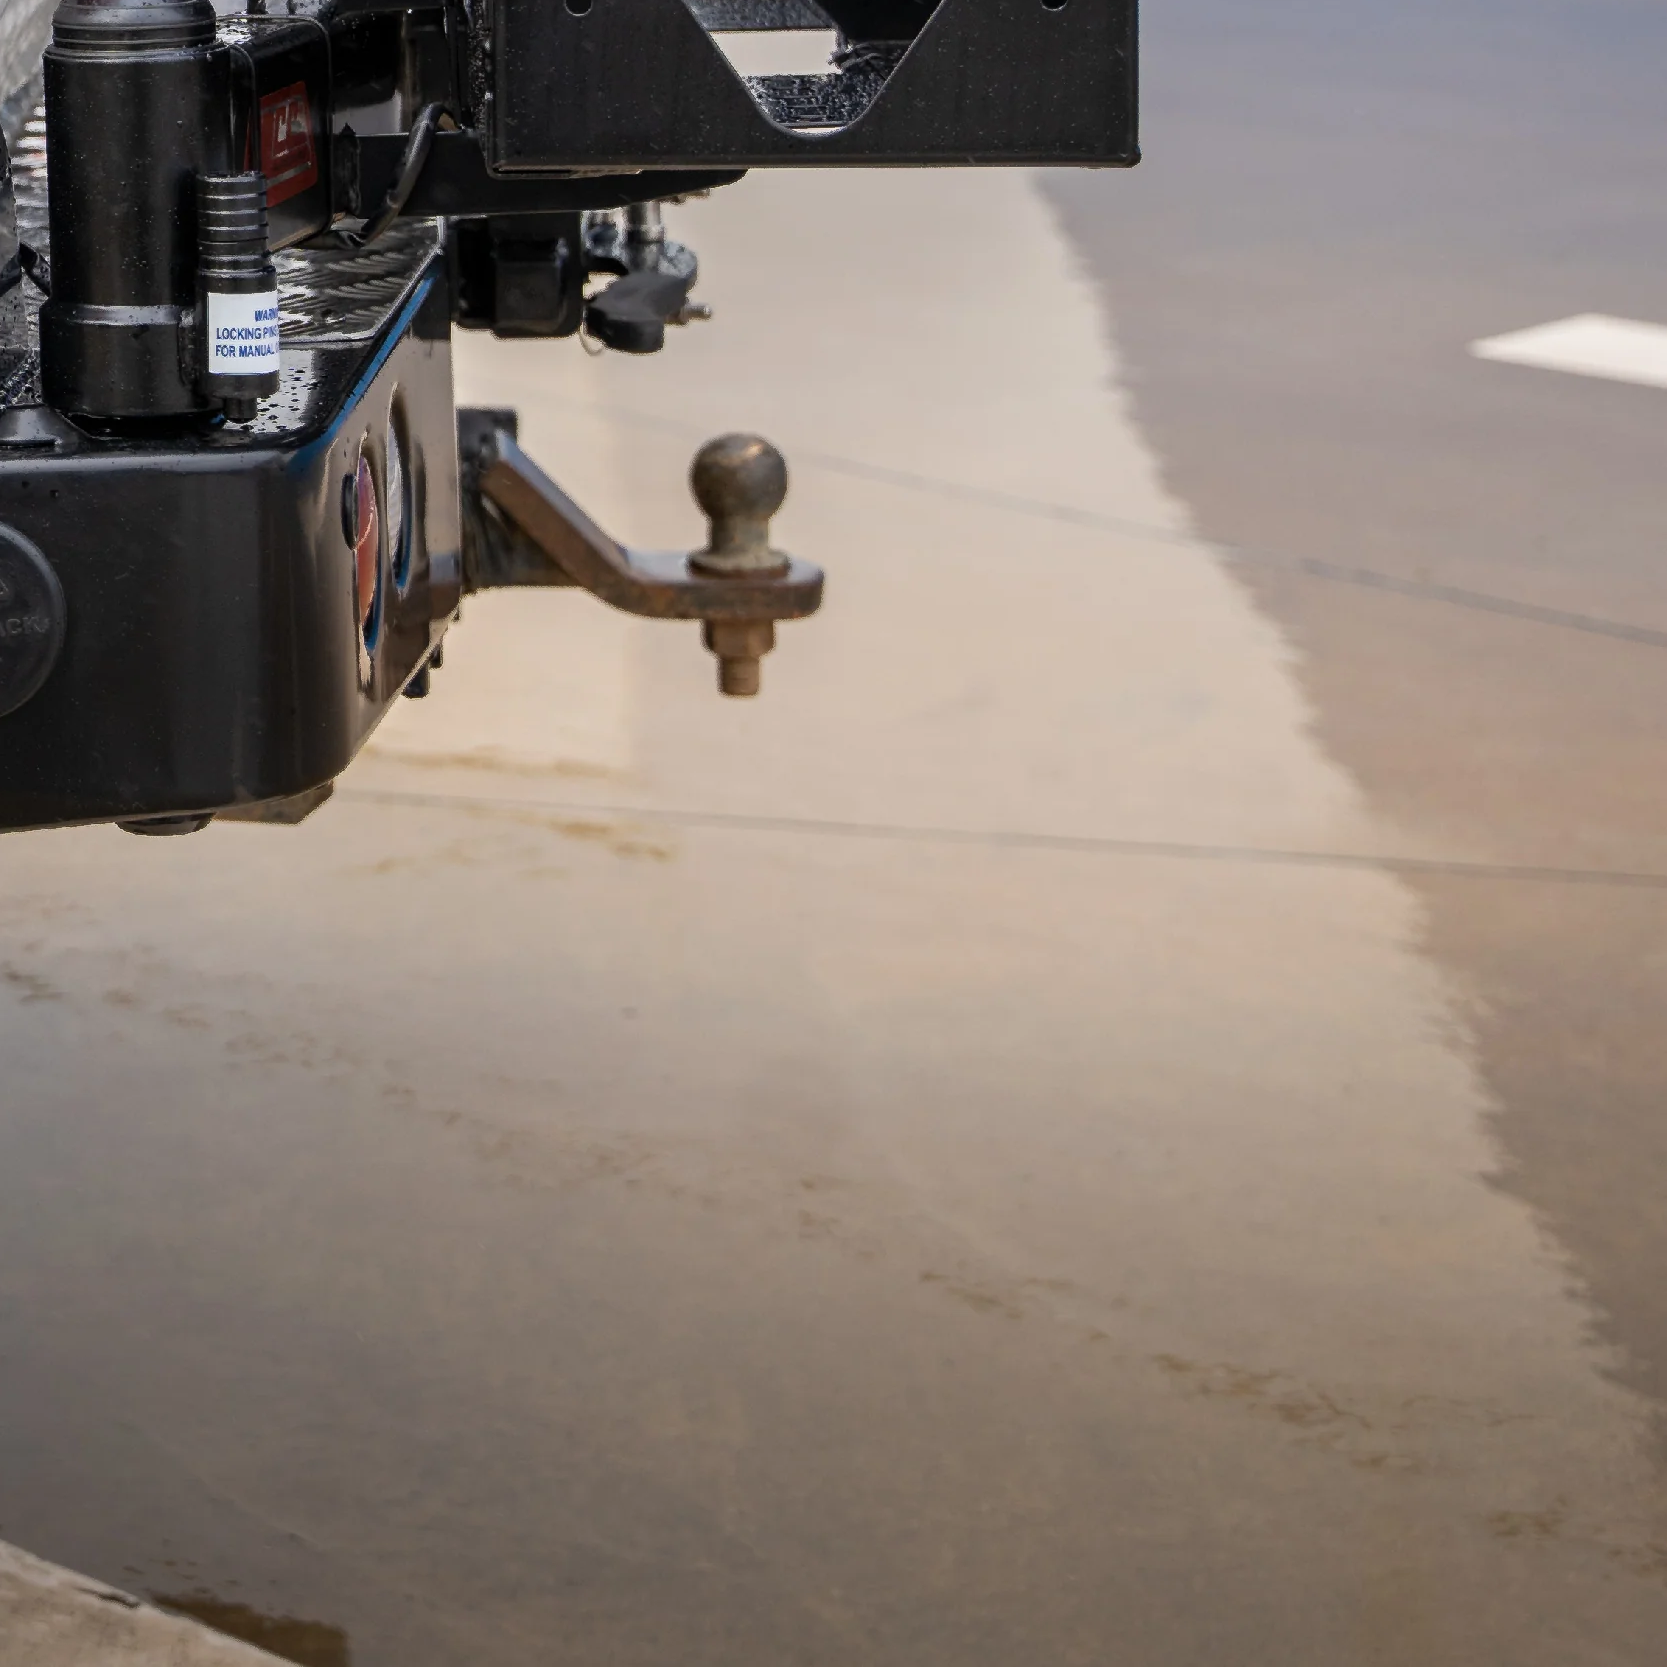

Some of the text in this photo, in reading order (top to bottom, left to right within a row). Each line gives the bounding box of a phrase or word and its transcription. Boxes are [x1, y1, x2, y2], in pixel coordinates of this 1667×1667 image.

[216, 327, 261, 340] LOCKING
[215, 345, 236, 358] FOR
[239, 344, 274, 358] MANUAL
